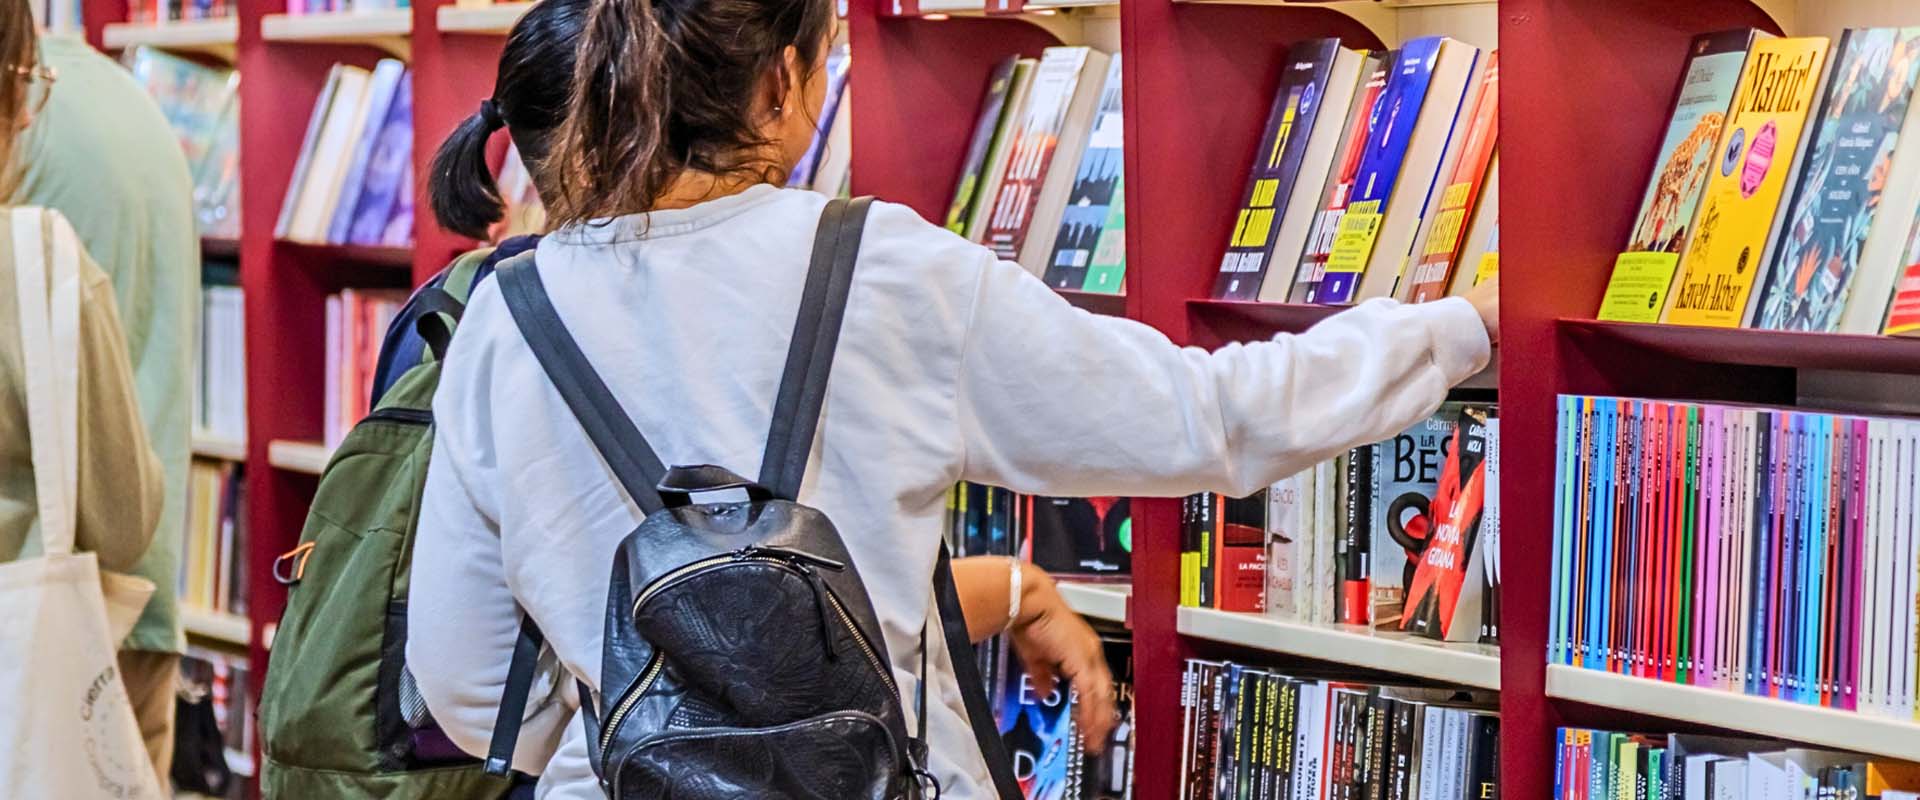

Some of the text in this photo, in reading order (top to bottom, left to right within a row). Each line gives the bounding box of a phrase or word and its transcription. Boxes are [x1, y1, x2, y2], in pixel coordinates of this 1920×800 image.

[1733, 51, 1817, 124] ¡Mártir!
[1675, 272, 1710, 310] Kaveh
[1707, 274, 1743, 312] Akbar
[1420, 434, 1436, 447] LA
[1448, 499, 1462, 519] LA
[1436, 523, 1461, 545] NOVIA
[1427, 547, 1455, 571] GITANA
